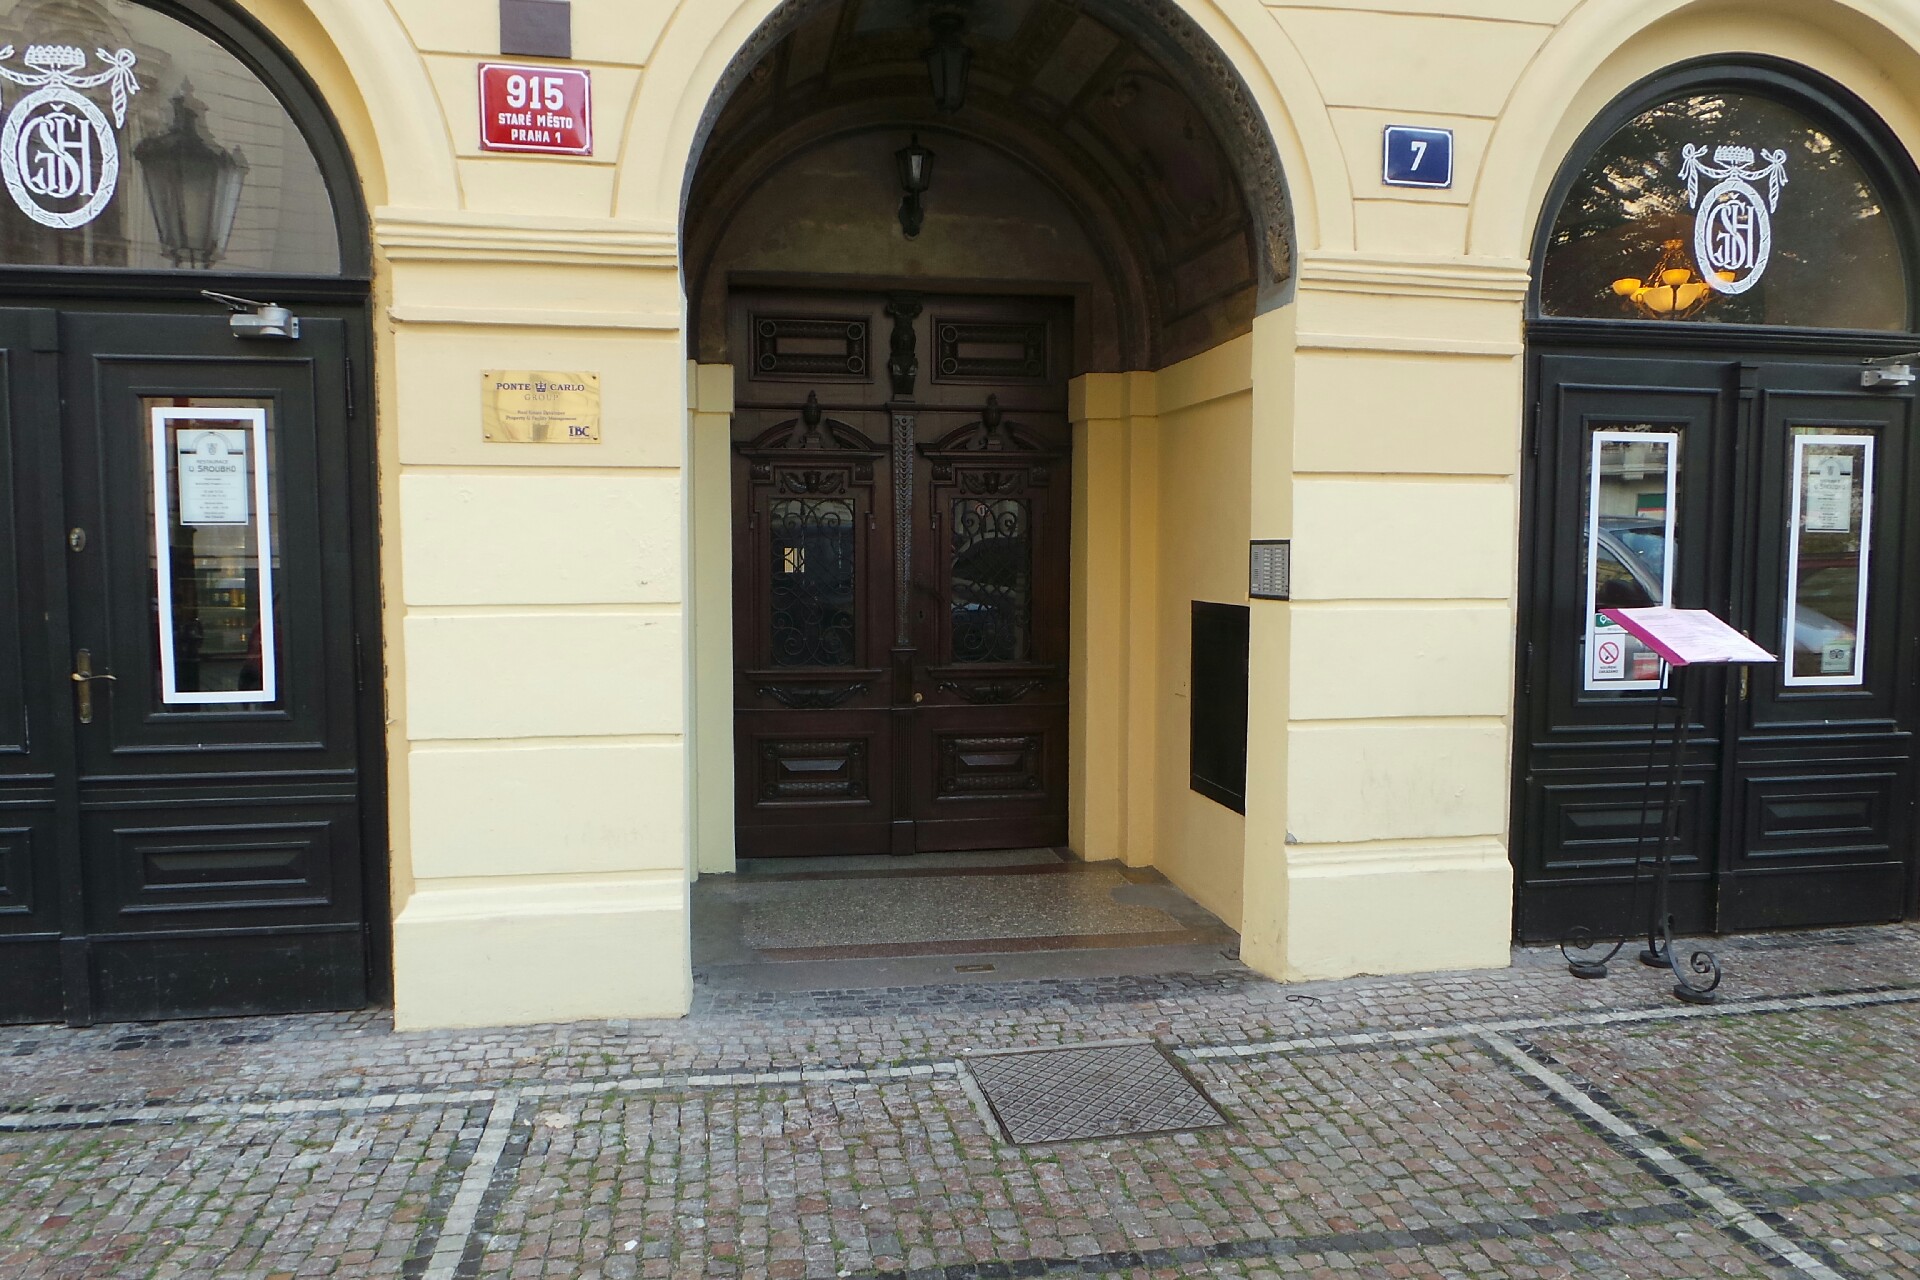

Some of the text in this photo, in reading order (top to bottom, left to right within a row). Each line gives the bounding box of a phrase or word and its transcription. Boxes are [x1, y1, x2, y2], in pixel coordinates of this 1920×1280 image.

[506, 74, 564, 110] 915
[498, 111, 573, 129] STARÉ MĚSTO
[511, 128, 561, 144] PRAHA 1
[1410, 141, 1428, 171] 7
[496, 382, 585, 391] PONTE CARLO
[569, 425, 590, 437] IBC
